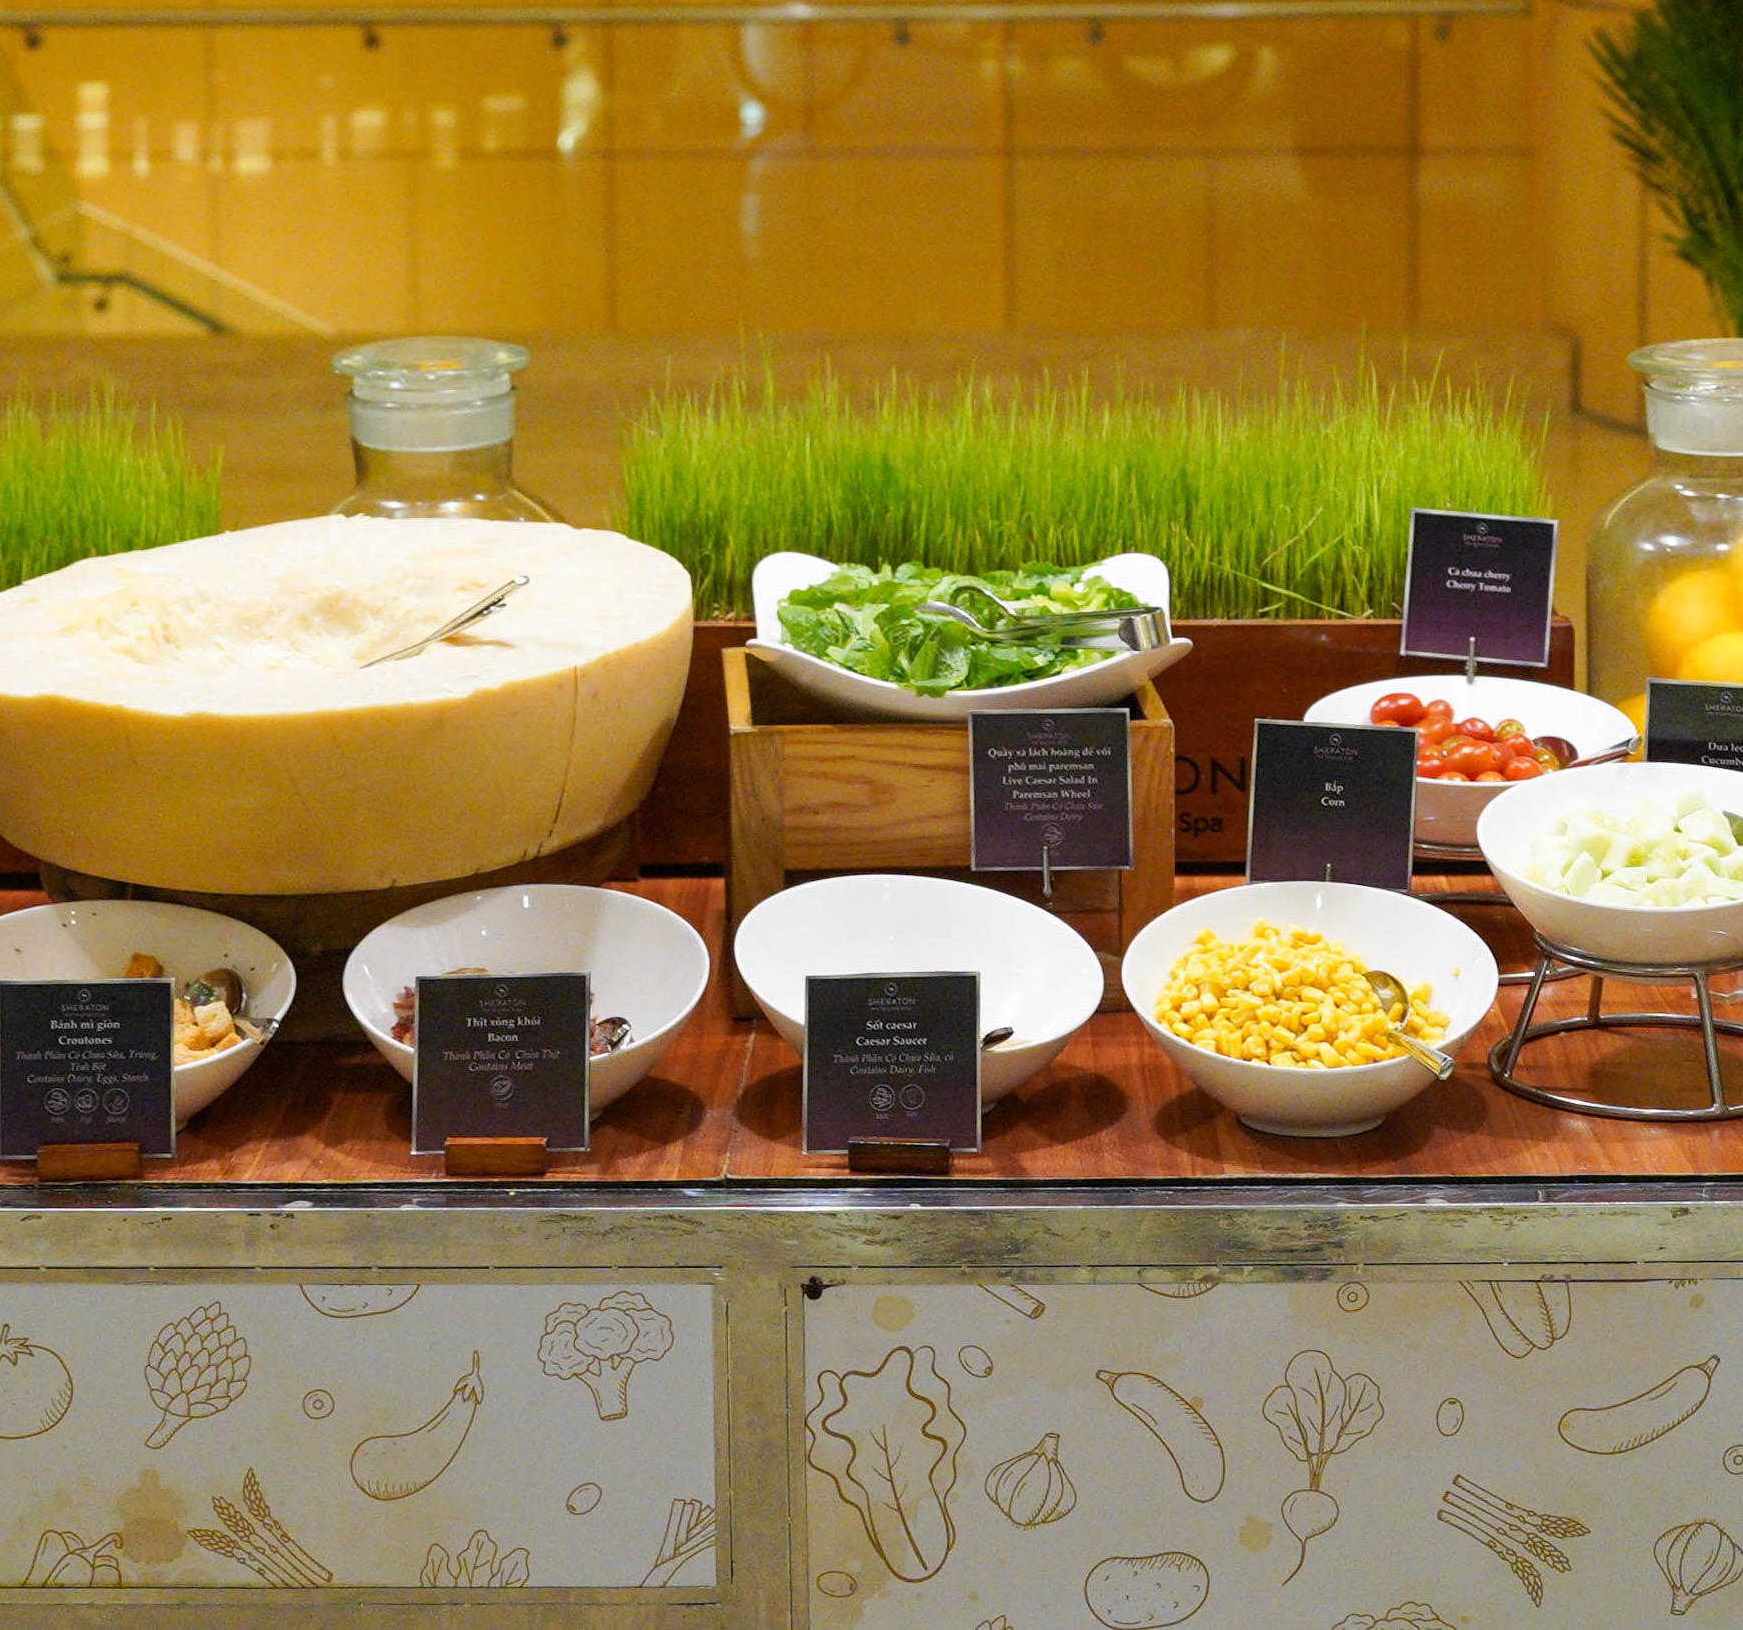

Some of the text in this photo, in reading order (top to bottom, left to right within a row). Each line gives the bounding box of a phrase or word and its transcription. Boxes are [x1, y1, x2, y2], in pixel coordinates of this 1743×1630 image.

[1462, 568, 1482, 578] chua
[1484, 570, 1511, 582] cherry
[1446, 580, 1511, 593] Cherry Tomato
[1002, 777, 1023, 785] Live
[1025, 776, 1056, 785] Caesar
[1059, 776, 1085, 784] Salad
[1061, 790, 1090, 798] Wheel
[1321, 797, 1345, 807] Corn
[1178, 813, 1223, 836] Spa
[50, 1020, 77, 1029] Bánh
[467, 1018, 487, 1029] Thịt
[517, 1016, 541, 1026] khói
[866, 1020, 917, 1030] Sốt caesar
[58, 1036, 113, 1045] Croutones
[487, 1033, 518, 1042] Bacon
[856, 1036, 927, 1046] Caesar Saucer
